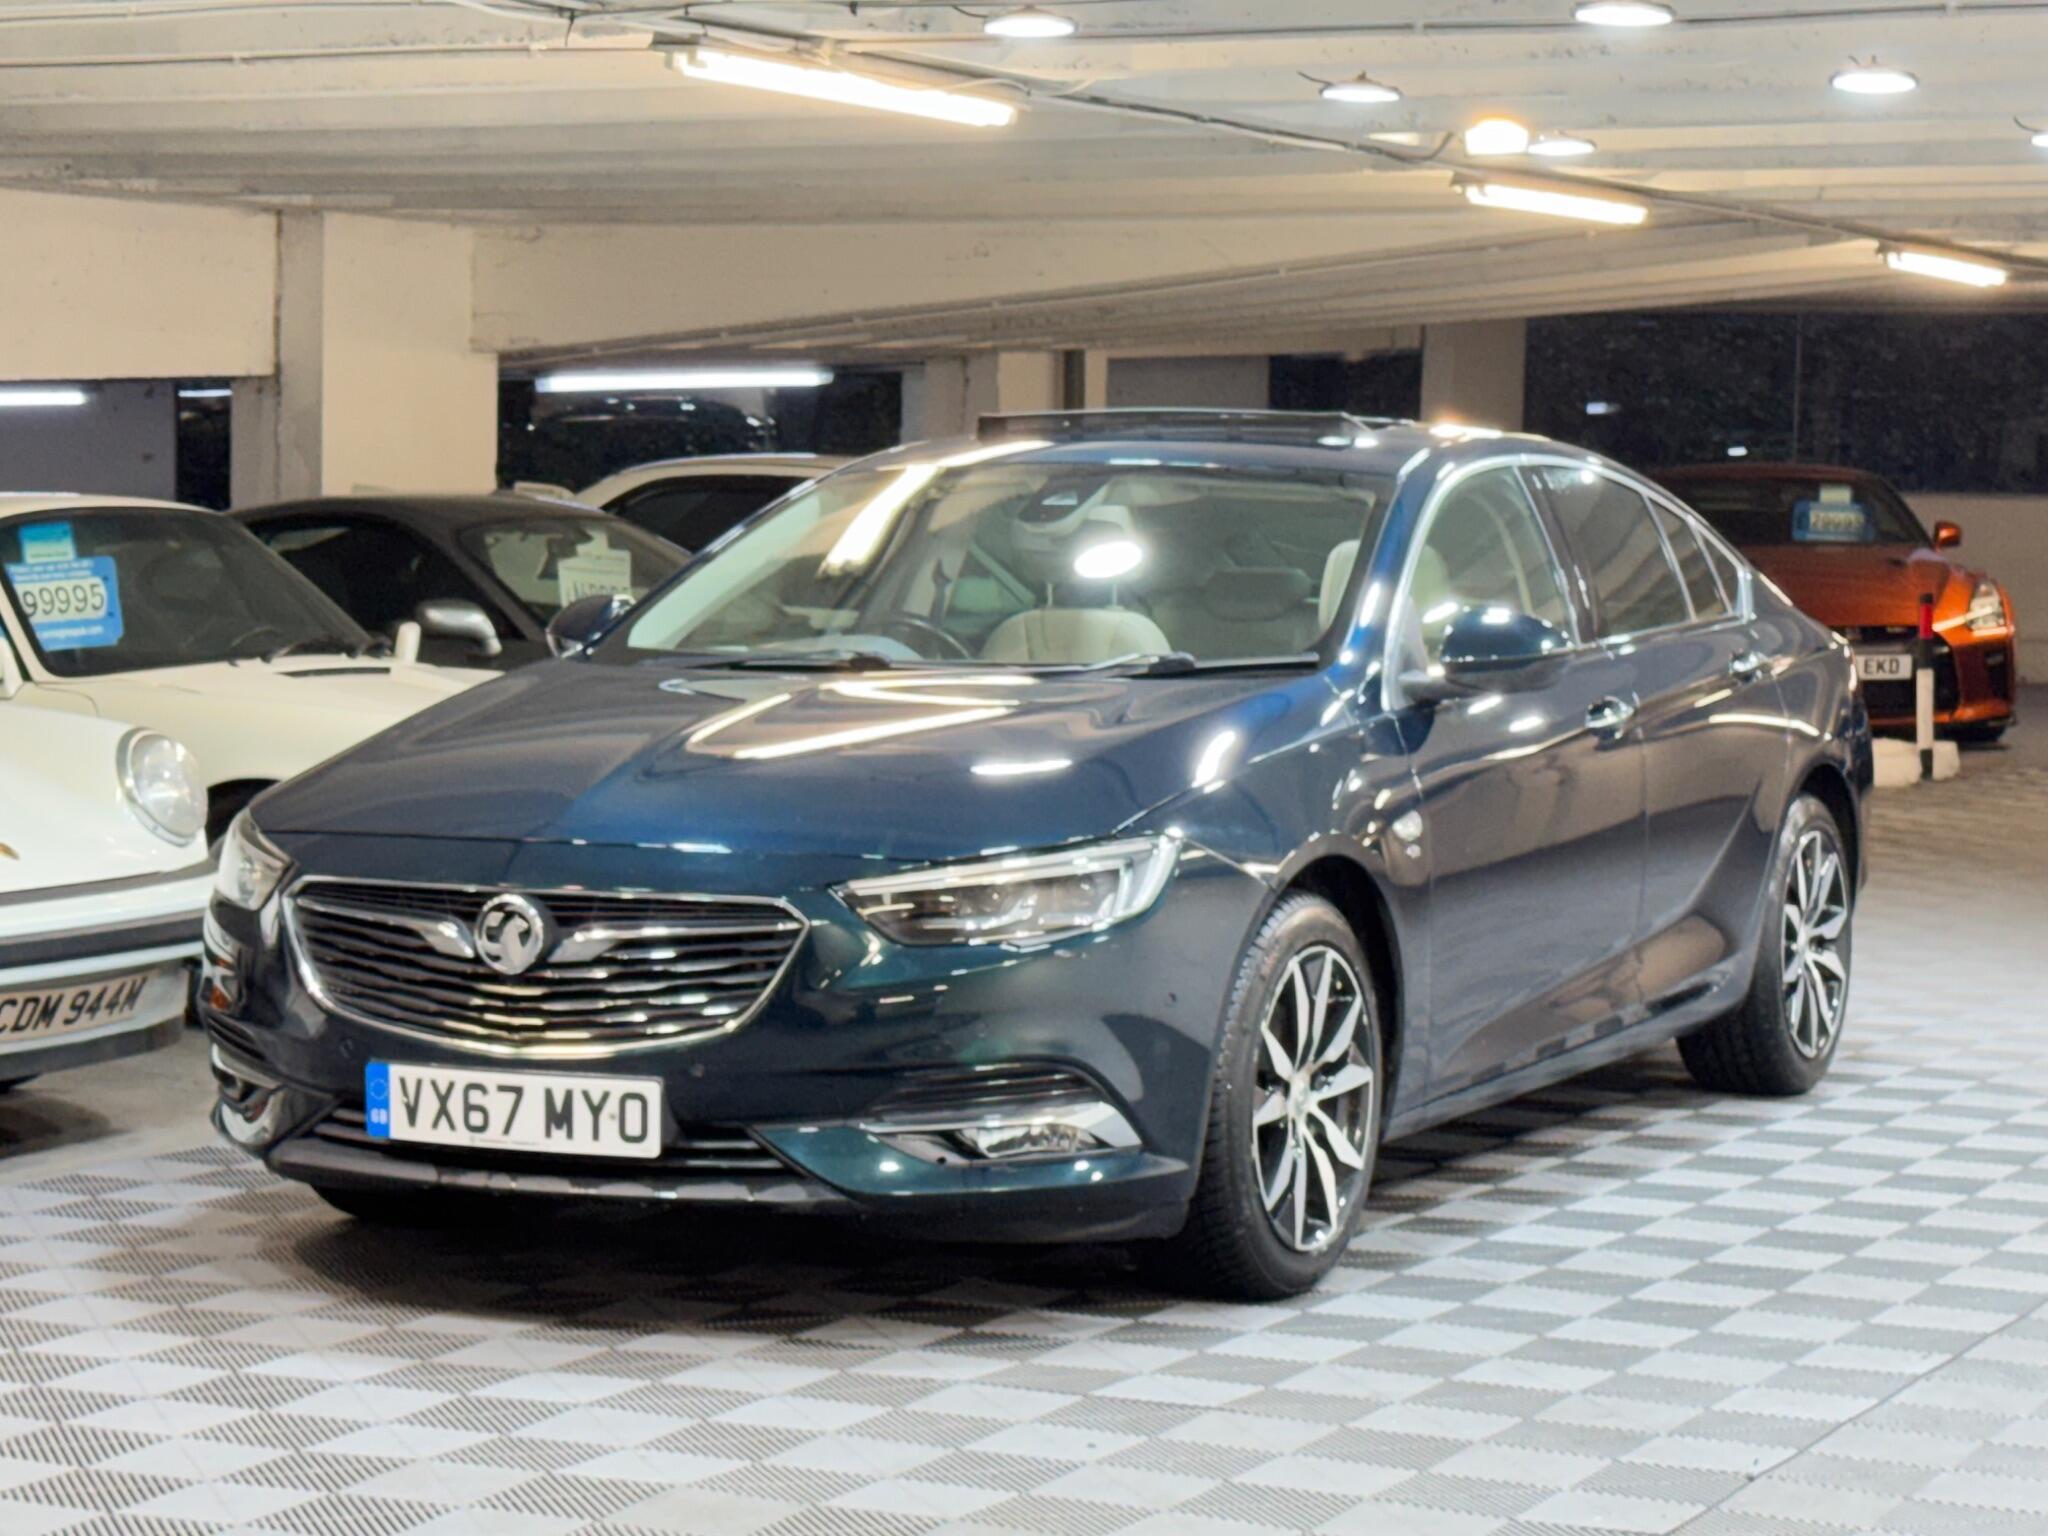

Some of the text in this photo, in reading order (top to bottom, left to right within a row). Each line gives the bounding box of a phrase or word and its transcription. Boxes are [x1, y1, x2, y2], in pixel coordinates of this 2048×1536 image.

[22, 584, 104, 617] 99995
[1863, 657, 1900, 675] EKD
[0, 993, 64, 1033] CDM
[399, 1076, 649, 1144] VX67 MYO
